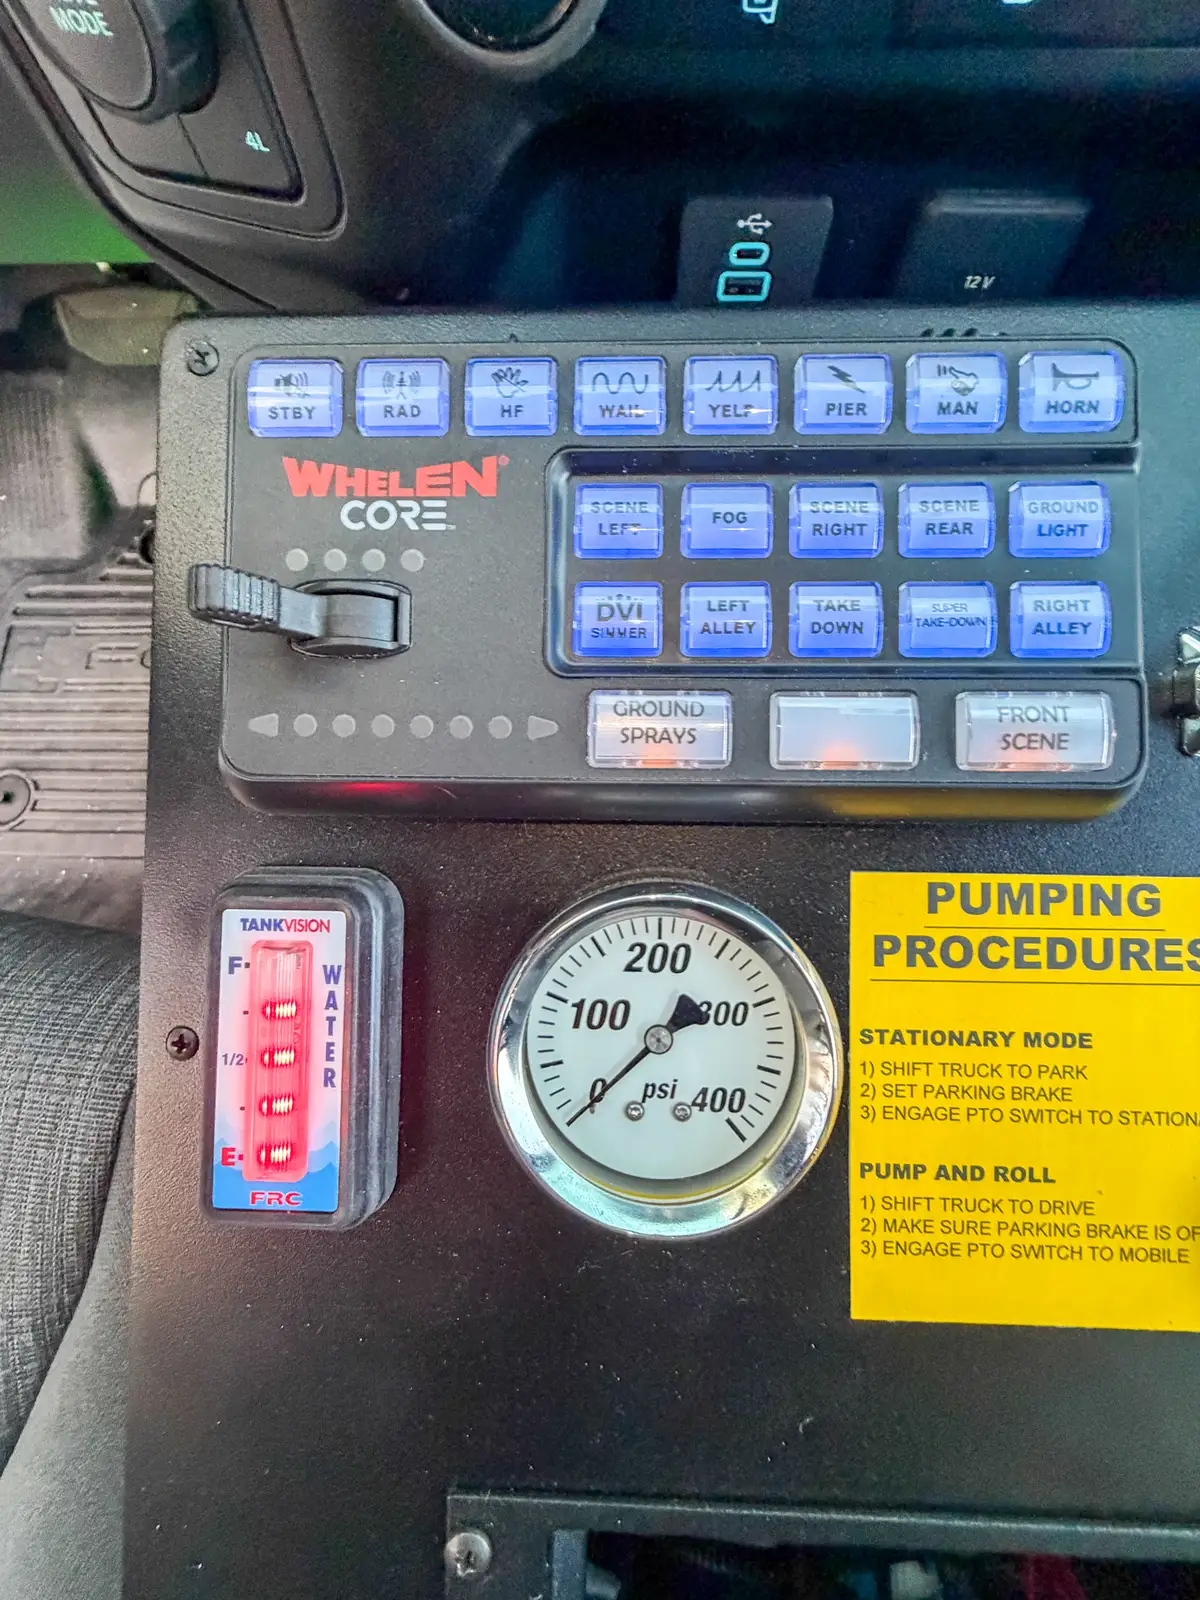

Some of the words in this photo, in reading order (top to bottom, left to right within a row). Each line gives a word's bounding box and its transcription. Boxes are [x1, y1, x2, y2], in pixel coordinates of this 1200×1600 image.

[49, 5, 114, 36] MODE
[268, 406, 316, 420] STBY
[384, 405, 421, 418] RAD
[500, 404, 524, 418] HF
[708, 404, 754, 418] YELP
[826, 402, 868, 417] PIER
[937, 402, 978, 416] MAN
[1046, 400, 1098, 415] HORN
[282, 455, 498, 497] WHELEN
[591, 501, 649, 514] SCENE
[810, 500, 869, 514] SCENE
[919, 500, 980, 513] SCENE
[1028, 501, 1098, 514] GROUND
[340, 500, 448, 531] CORE
[712, 511, 748, 524] FOG
[598, 523, 642, 536] LEFT
[813, 523, 867, 537] RIGHT
[925, 522, 973, 536] REAR
[1037, 524, 1088, 538] LIGHT
[597, 602, 642, 622] DVI
[706, 600, 750, 612] LEFT
[813, 600, 861, 612] TAKE
[931, 603, 968, 612] SUPER
[1033, 600, 1090, 613] RIGHT
[700, 622, 756, 635] ALLEY
[811, 622, 864, 635] DOWN
[915, 617, 986, 628] TAKE-DOWN
[1032, 622, 1092, 635] ALLEY
[613, 701, 705, 719] GROUND
[998, 705, 1069, 723] FRONT
[620, 727, 697, 746] SPRAYS
[1000, 732, 1069, 751] SCENE
[927, 882, 1161, 917] PUMPING
[240, 918, 330, 933] TANKVISION
[227, 957, 242, 974] F
[623, 942, 692, 974] 200
[571, 999, 631, 1030] 100
[322, 964, 342, 1088] WATER
[859, 1029, 1015, 1047] STATIONARY
[1023, 1032, 1093, 1049] MODE
[222, 1054, 243, 1066] 1/2
[860, 1062, 875, 1078] 1)
[881, 1062, 933, 1078] SHIFT
[941, 1062, 1003, 1079] TRUCK
[1007, 1064, 1032, 1079] TO
[1038, 1065, 1088, 1080] PARK
[641, 1079, 679, 1103] psi
[860, 1084, 876, 1100] 2)
[882, 1084, 917, 1099] SET
[924, 1085, 1005, 1101] PARKING
[1011, 1087, 1073, 1102] BRAKE
[691, 1087, 746, 1113] 400
[860, 1106, 876, 1123] 3)
[883, 1106, 961, 1122] ENGAGE
[967, 1108, 1003, 1123] PTO
[1009, 1109, 1082, 1125] SWITCH
[1090, 1110, 1113, 1125] TO
[1118, 1111, 1200, 1127] STATION
[221, 1148, 236, 1166] E
[859, 1162, 927, 1180] PUMP
[934, 1164, 985, 1182] AND
[994, 1166, 1056, 1184] ROLL
[249, 1191, 303, 1206] FRC
[860, 1195, 875, 1212] 1)
[881, 1195, 934, 1212] SHIFT
[940, 1197, 1003, 1213] TRUCK
[1008, 1199, 1033, 1214] TO
[1040, 1200, 1095, 1216] DRIVE
[861, 1218, 877, 1235] 2)
[883, 1219, 934, 1234] MAKE
[940, 1220, 991, 1236] SURE
[997, 1221, 1080, 1238] PARKING
[1087, 1223, 1149, 1240] BRAKE
[1154, 1224, 1171, 1241] IS
[861, 1240, 877, 1257] 3)
[883, 1240, 961, 1257] ENGAGE
[968, 1242, 1004, 1258] PTO
[1011, 1244, 1082, 1260] SWITCH
[1090, 1246, 1113, 1261] TO
[1120, 1247, 1190, 1263] MOBILE
